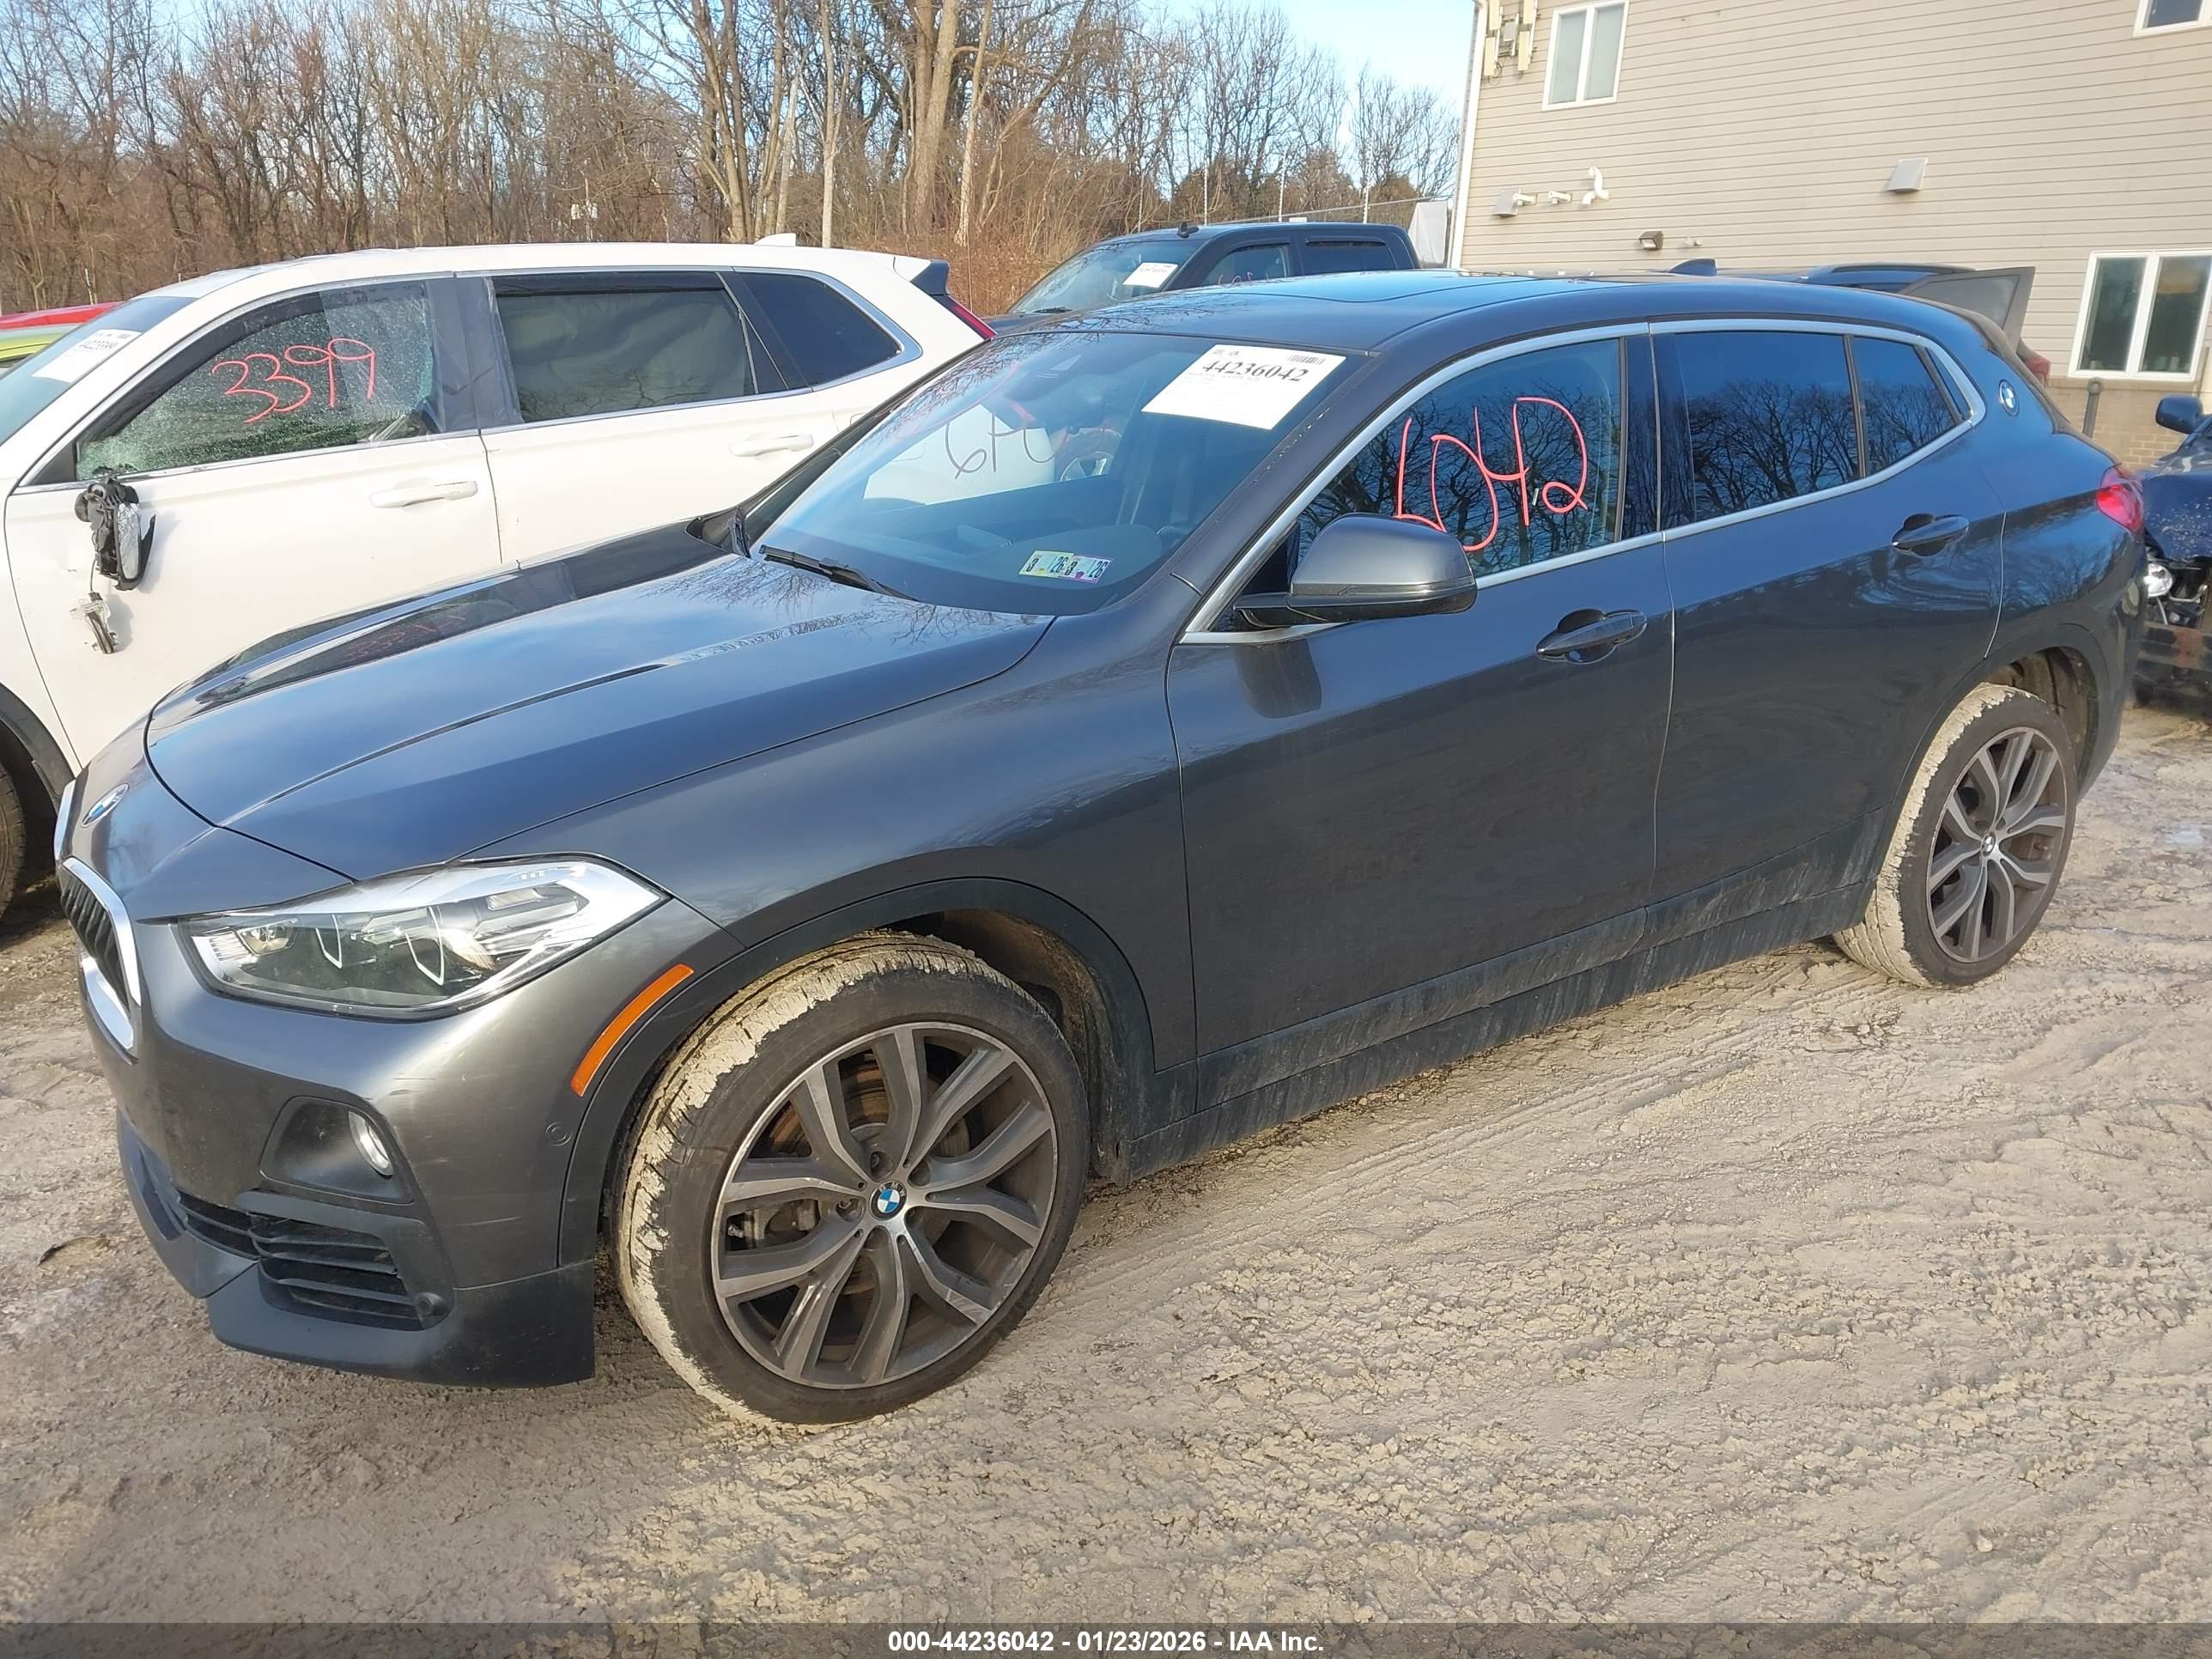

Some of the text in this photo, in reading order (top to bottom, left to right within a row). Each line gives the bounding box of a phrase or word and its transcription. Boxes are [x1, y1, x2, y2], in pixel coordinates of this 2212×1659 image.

[211, 337, 376, 423] 3399
[1202, 361, 1309, 382] 44236042
[878, 1182, 907, 1198] BMW
